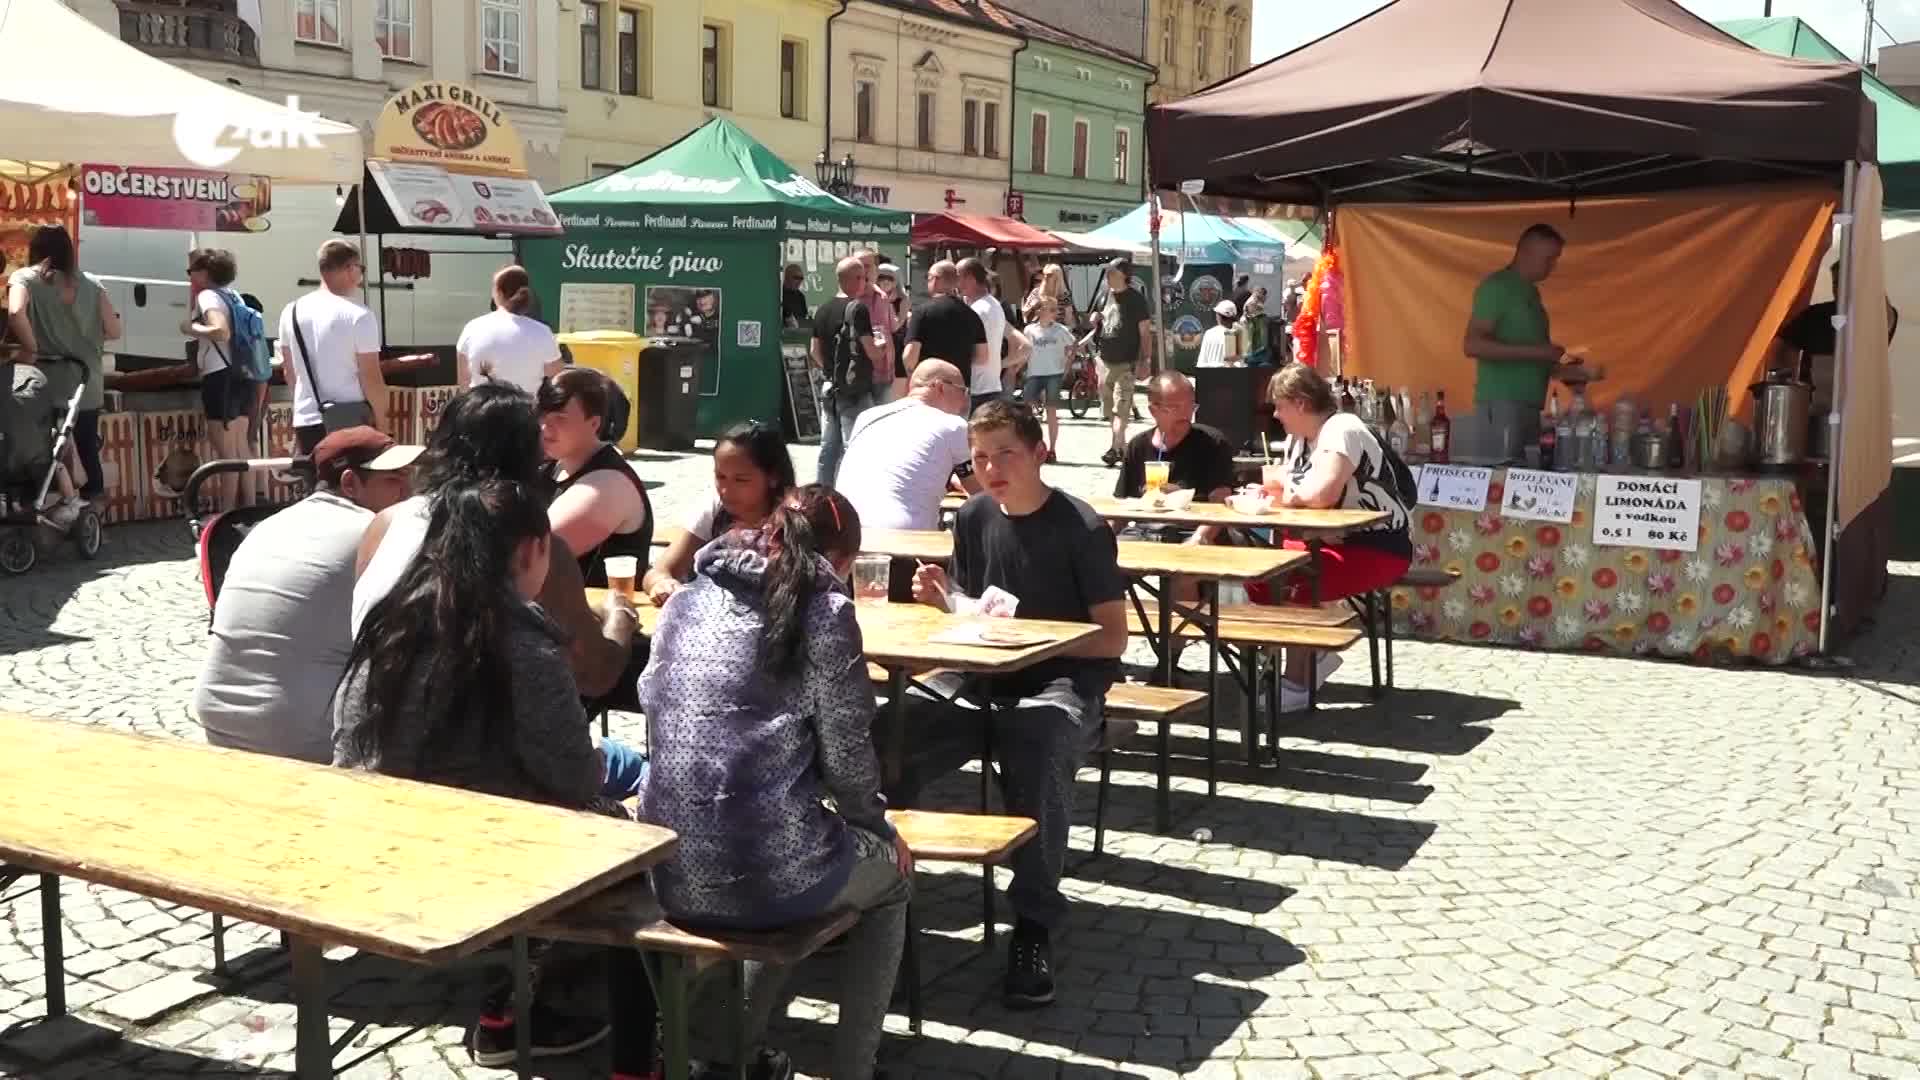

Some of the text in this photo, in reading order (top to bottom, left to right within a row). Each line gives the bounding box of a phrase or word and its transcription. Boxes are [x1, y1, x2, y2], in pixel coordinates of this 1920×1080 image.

[394, 84, 501, 127] MAXI GRILL
[84, 166, 229, 202] OBČERSTVENÍ
[643, 213, 687, 229] Ferdinand
[732, 215, 778, 230] Ferdinand
[561, 242, 724, 278] Skutečné pivo
[1425, 465, 1487, 480] PROSECCO
[1616, 480, 1679, 494] DOMÁCÍ
[1605, 495, 1688, 511] LIMONÁDA
[1625, 513, 1677, 524] vodkou
[1647, 529, 1665, 540] 80
[1668, 530, 1688, 542] Kč
